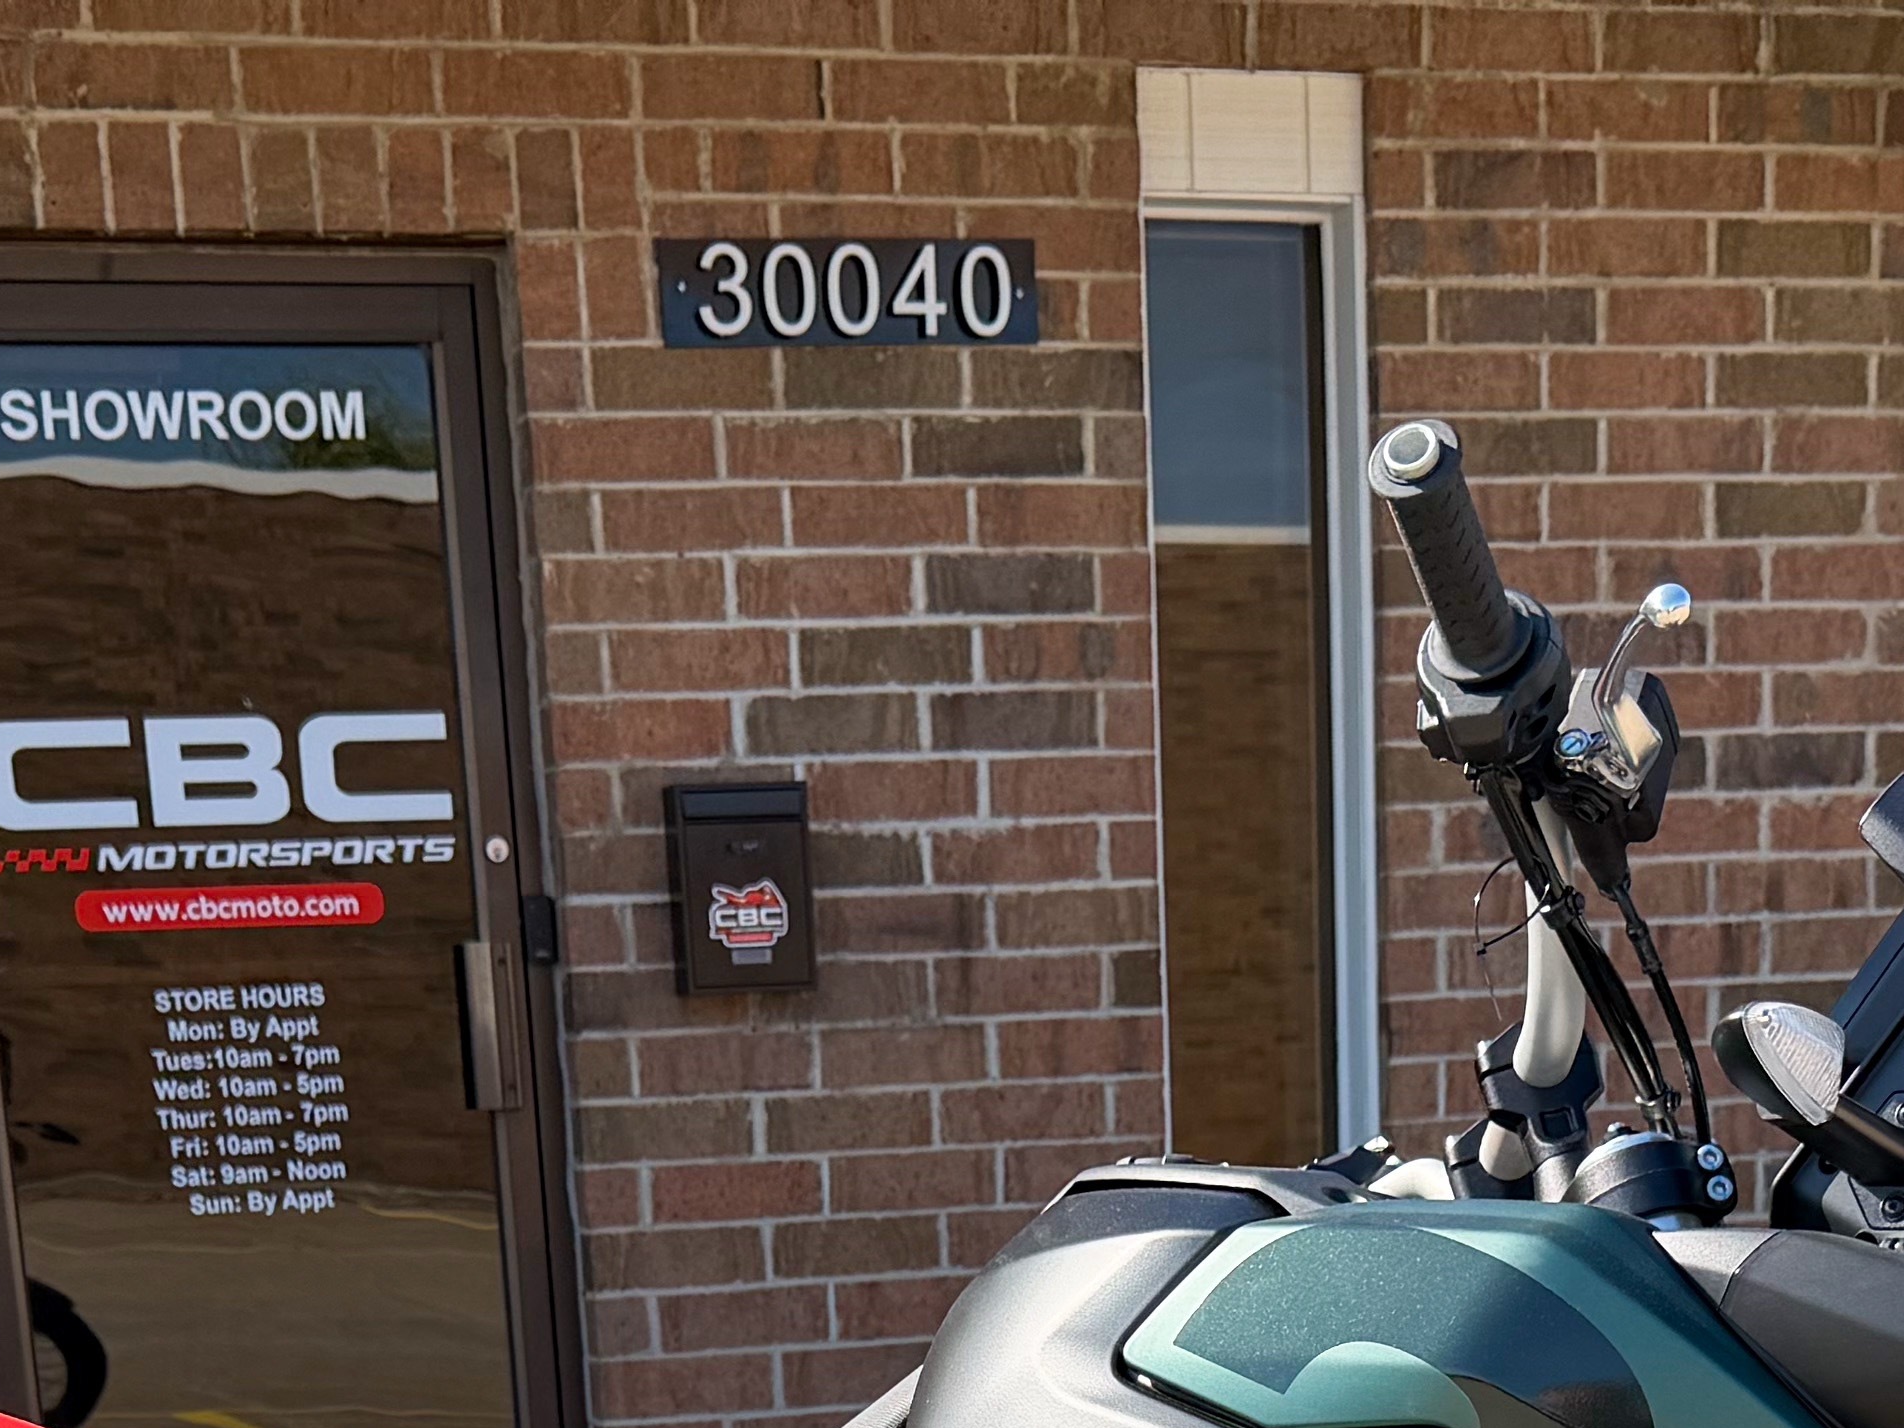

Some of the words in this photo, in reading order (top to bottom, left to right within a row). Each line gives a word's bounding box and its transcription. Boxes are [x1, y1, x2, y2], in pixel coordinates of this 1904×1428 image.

[698, 241, 1013, 338] 30040
[96, 834, 457, 873] MOTORSPORTS
[101, 892, 361, 926] www.cbcmoto.com
[715, 906, 785, 928] CBC
[153, 986, 236, 1014] STORE
[240, 981, 325, 1009] HOURS
[166, 1017, 225, 1043] Mon:
[229, 1014, 261, 1044] By
[265, 1012, 320, 1043] Appt
[290, 1042, 341, 1070] 7pm
[152, 1076, 212, 1102] Wed:
[216, 1073, 279, 1099] 10am
[296, 1070, 345, 1099] 5pm
[154, 1105, 217, 1131] Thur:
[221, 1102, 283, 1128] 10am
[298, 1099, 349, 1128] 7pm
[168, 1134, 210, 1160] Fri:
[214, 1132, 275, 1158] 10am
[292, 1130, 342, 1158] 5pm
[169, 1162, 216, 1189] Sat:
[219, 1161, 269, 1187] 9am
[285, 1157, 347, 1183] Noon
[188, 1192, 242, 1217] Sun:
[246, 1188, 278, 1217] By
[282, 1184, 336, 1215] Appt
